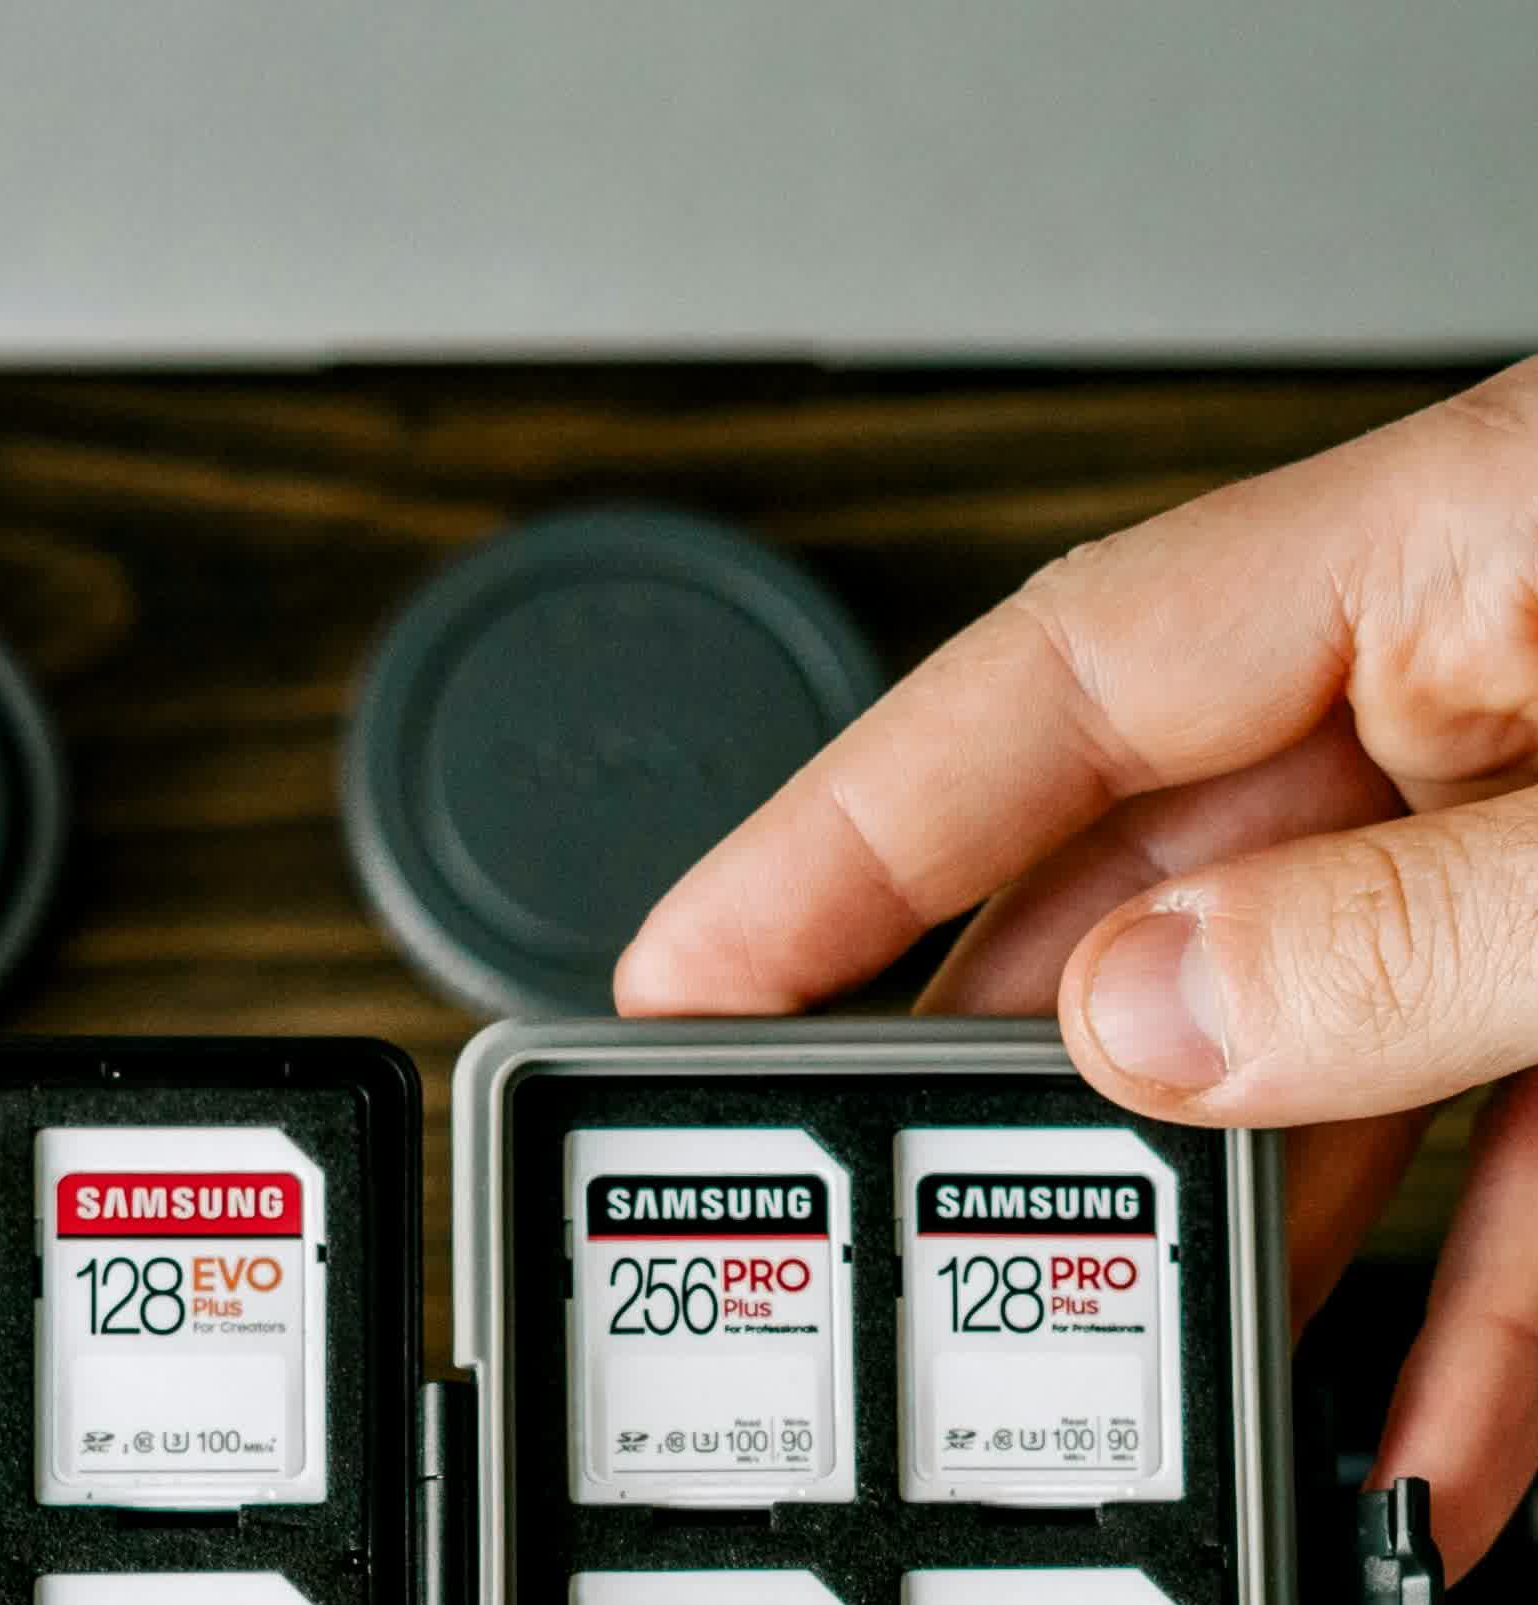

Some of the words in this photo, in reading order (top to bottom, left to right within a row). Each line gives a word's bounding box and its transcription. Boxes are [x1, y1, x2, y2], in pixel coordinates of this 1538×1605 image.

[76, 1186, 285, 1220] SAMSUNG
[606, 1187, 812, 1220] SAMSUNG
[936, 1186, 1140, 1220] SAMSUNG
[77, 1257, 185, 1336] 128
[192, 1257, 283, 1292] EVO
[192, 1299, 242, 1317] Plus
[609, 1257, 718, 1336] 256
[723, 1258, 811, 1293] PRO
[723, 1299, 772, 1318] Plus
[938, 1256, 1044, 1333] 128
[1051, 1256, 1137, 1290] PRO
[1051, 1297, 1099, 1315] Plus
[198, 1430, 240, 1453] 100
[726, 1430, 768, 1452] 100
[781, 1430, 812, 1452] 90
[1054, 1429, 1095, 1450] 100
[1107, 1429, 1139, 1450] 90
